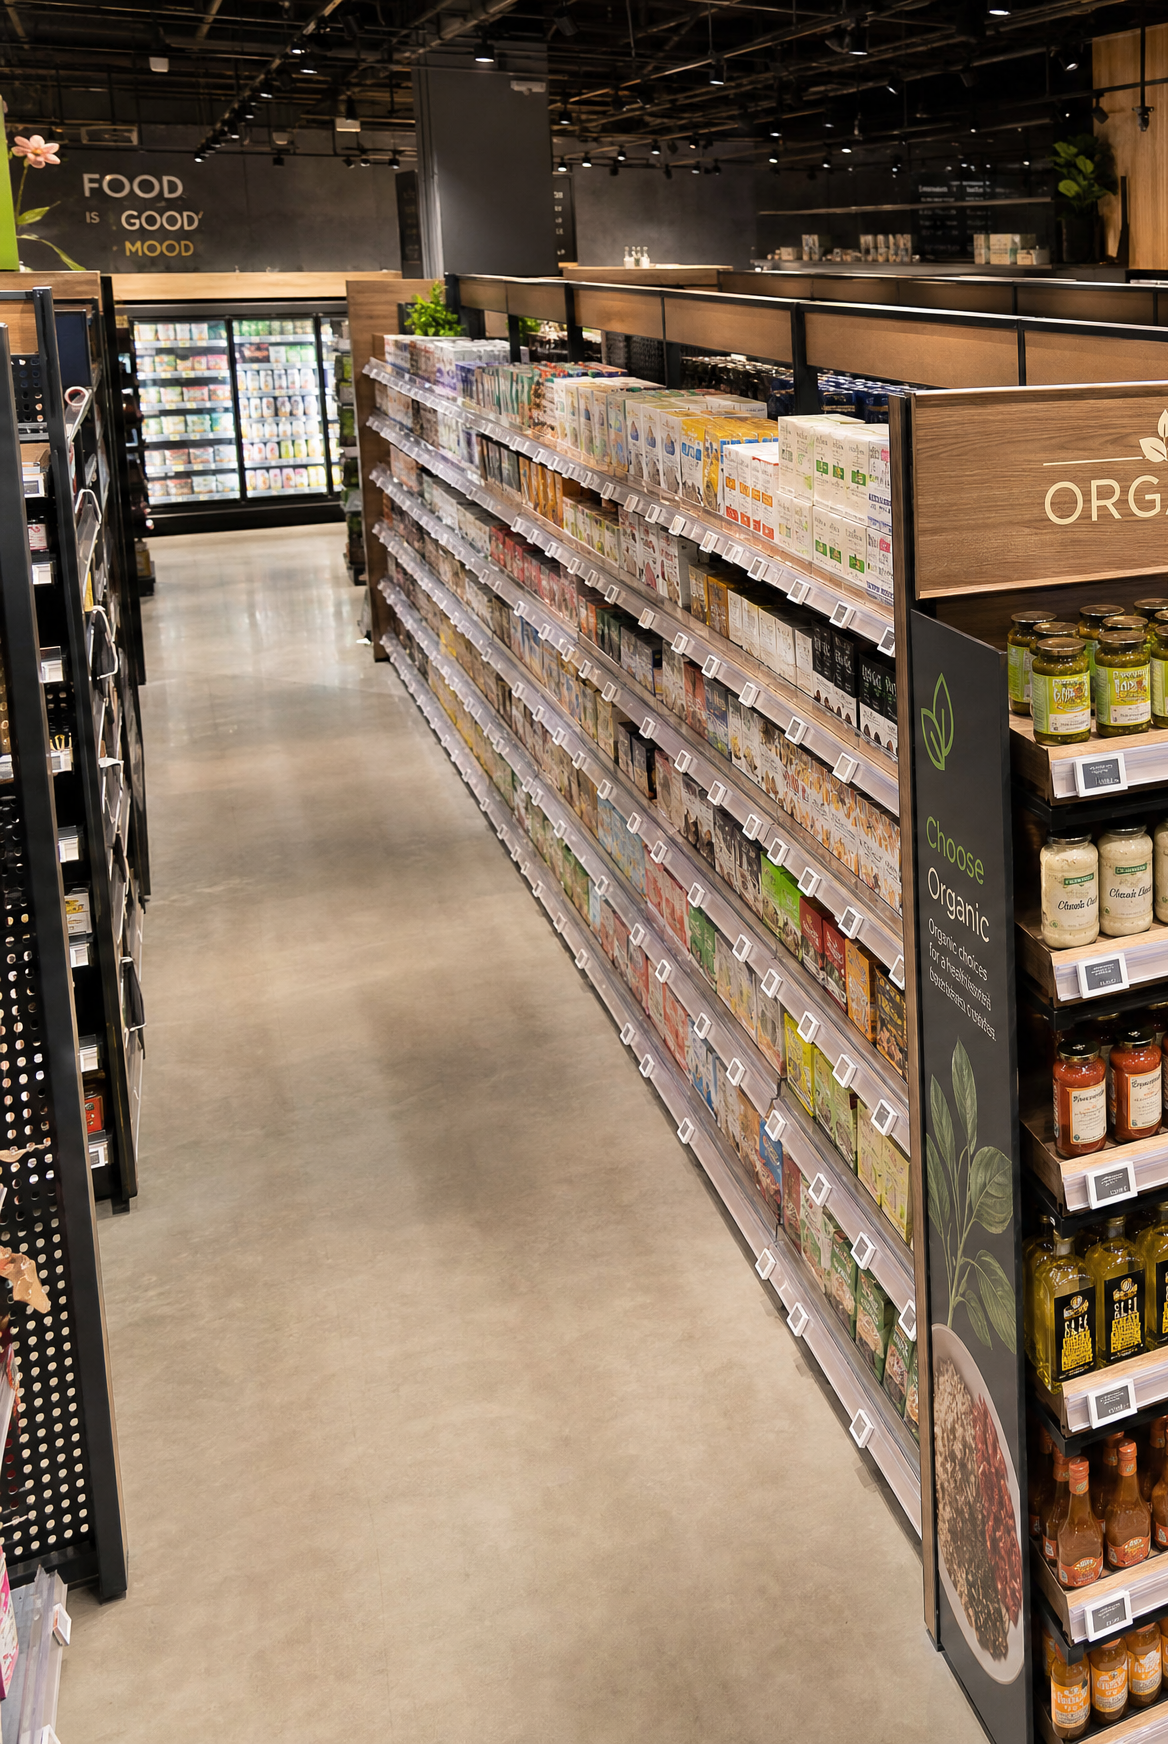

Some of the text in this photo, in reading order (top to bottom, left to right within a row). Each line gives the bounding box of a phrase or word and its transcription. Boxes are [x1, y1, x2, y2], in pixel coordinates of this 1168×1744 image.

[83, 173, 183, 198] FOOD
[86, 210, 199, 231] IS GOOD
[125, 240, 194, 256] MOOD
[926, 816, 984, 885] Choose
[928, 867, 990, 943] Organic
[928, 918, 988, 981] Organic choices
[929, 941, 941, 964] for
